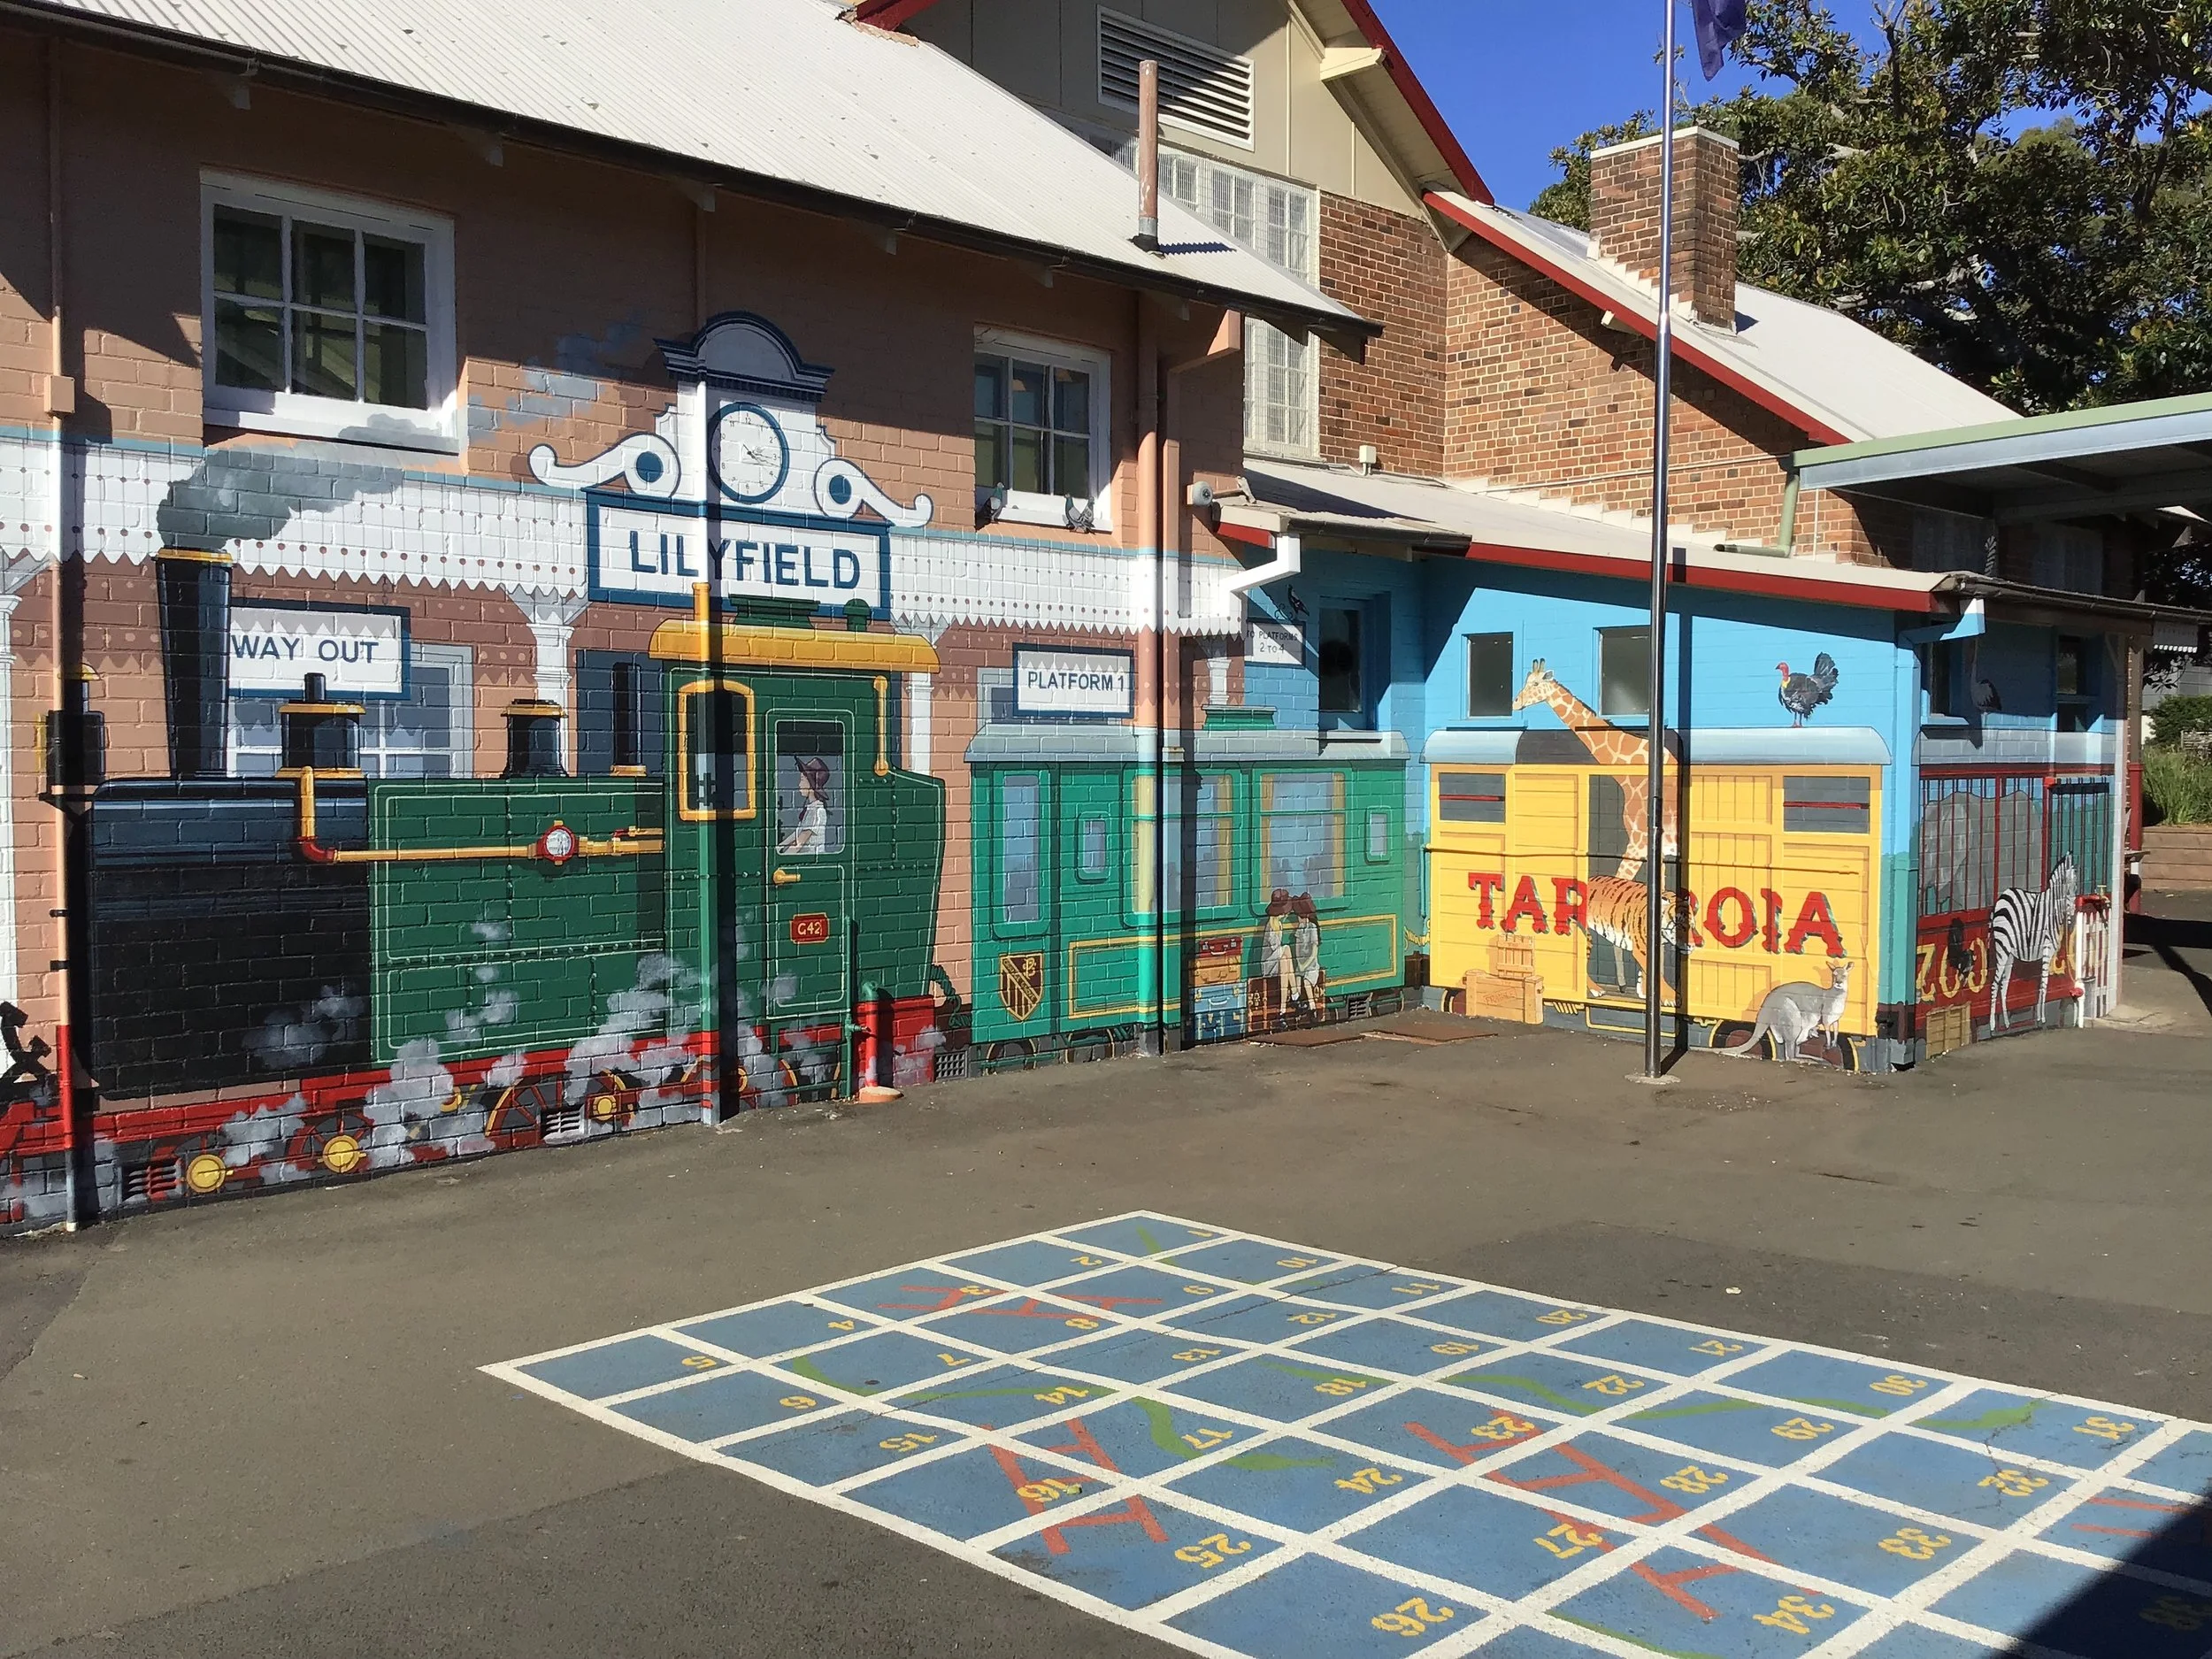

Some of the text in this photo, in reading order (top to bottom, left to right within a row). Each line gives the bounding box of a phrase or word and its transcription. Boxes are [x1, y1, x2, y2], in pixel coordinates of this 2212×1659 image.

[630, 531, 860, 589] LILYFIELD
[1258, 631, 1298, 641] PLATFORMS
[231, 634, 379, 664] WAY OUT
[1259, 641, 1265, 653] 2
[1267, 645, 1278, 654] TO
[1028, 671, 1125, 692] PLATFORM 1
[1071, 1255, 1103, 1266] 2
[1391, 1283, 1441, 1295] 11
[827, 1318, 856, 1332] 4
[1064, 1317, 1102, 1330] 8
[1536, 1309, 1587, 1325] 20
[1171, 1347, 1221, 1363] 13
[1430, 1340, 1480, 1356] 19
[1689, 1340, 1743, 1356] 21
[681, 1356, 717, 1371] 5
[937, 1353, 970, 1367] 7
[1315, 1378, 1369, 1396] 18
[1584, 1375, 1644, 1395] 22
[1870, 1375, 1927, 1395] 30
[1034, 1386, 1091, 1405] 14
[1470, 1416, 1534, 1441] 23
[1771, 1417, 1834, 1440] 29
[2073, 1417, 2135, 1440] 31
[879, 1432, 936, 1452] 15
[1183, 1429, 1233, 1449] 17
[1335, 1468, 1403, 1494] 24
[1659, 1465, 1729, 1494] 28
[1978, 1469, 2049, 1497] 32
[1173, 1533, 1252, 1569] 25
[1532, 1522, 1604, 1560] 27
[1878, 1528, 1952, 1560] 33
[1371, 1597, 1455, 1637] 26
[1754, 1595, 1835, 1635] 34
